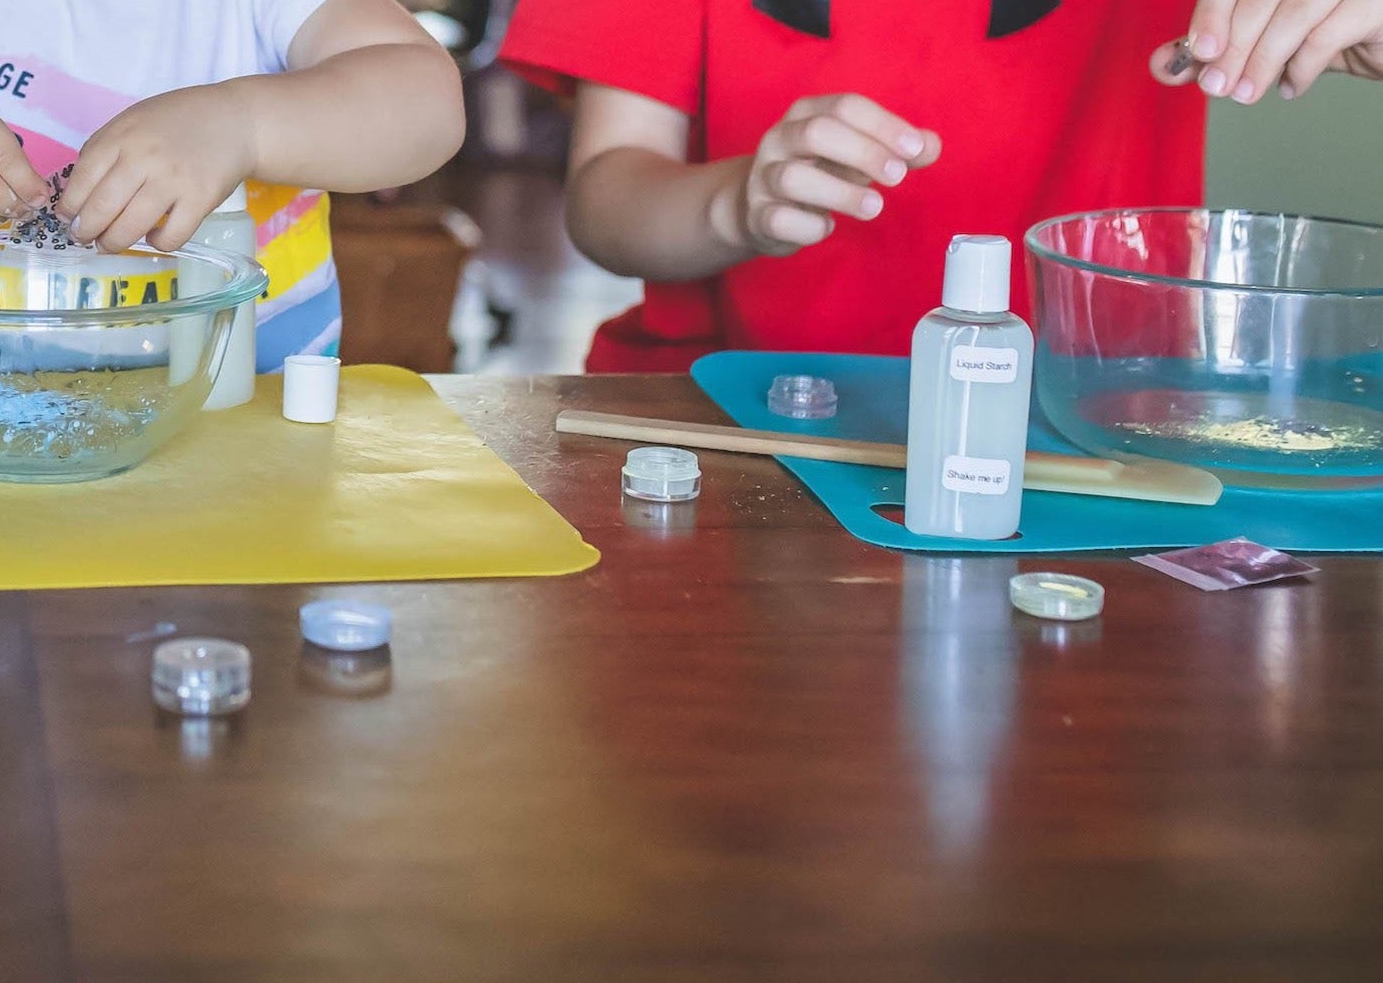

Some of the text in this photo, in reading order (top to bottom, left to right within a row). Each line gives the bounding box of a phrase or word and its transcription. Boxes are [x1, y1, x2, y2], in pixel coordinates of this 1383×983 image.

[957, 359, 1011, 370] Liquid Starch
[947, 469, 976, 481] Shake
